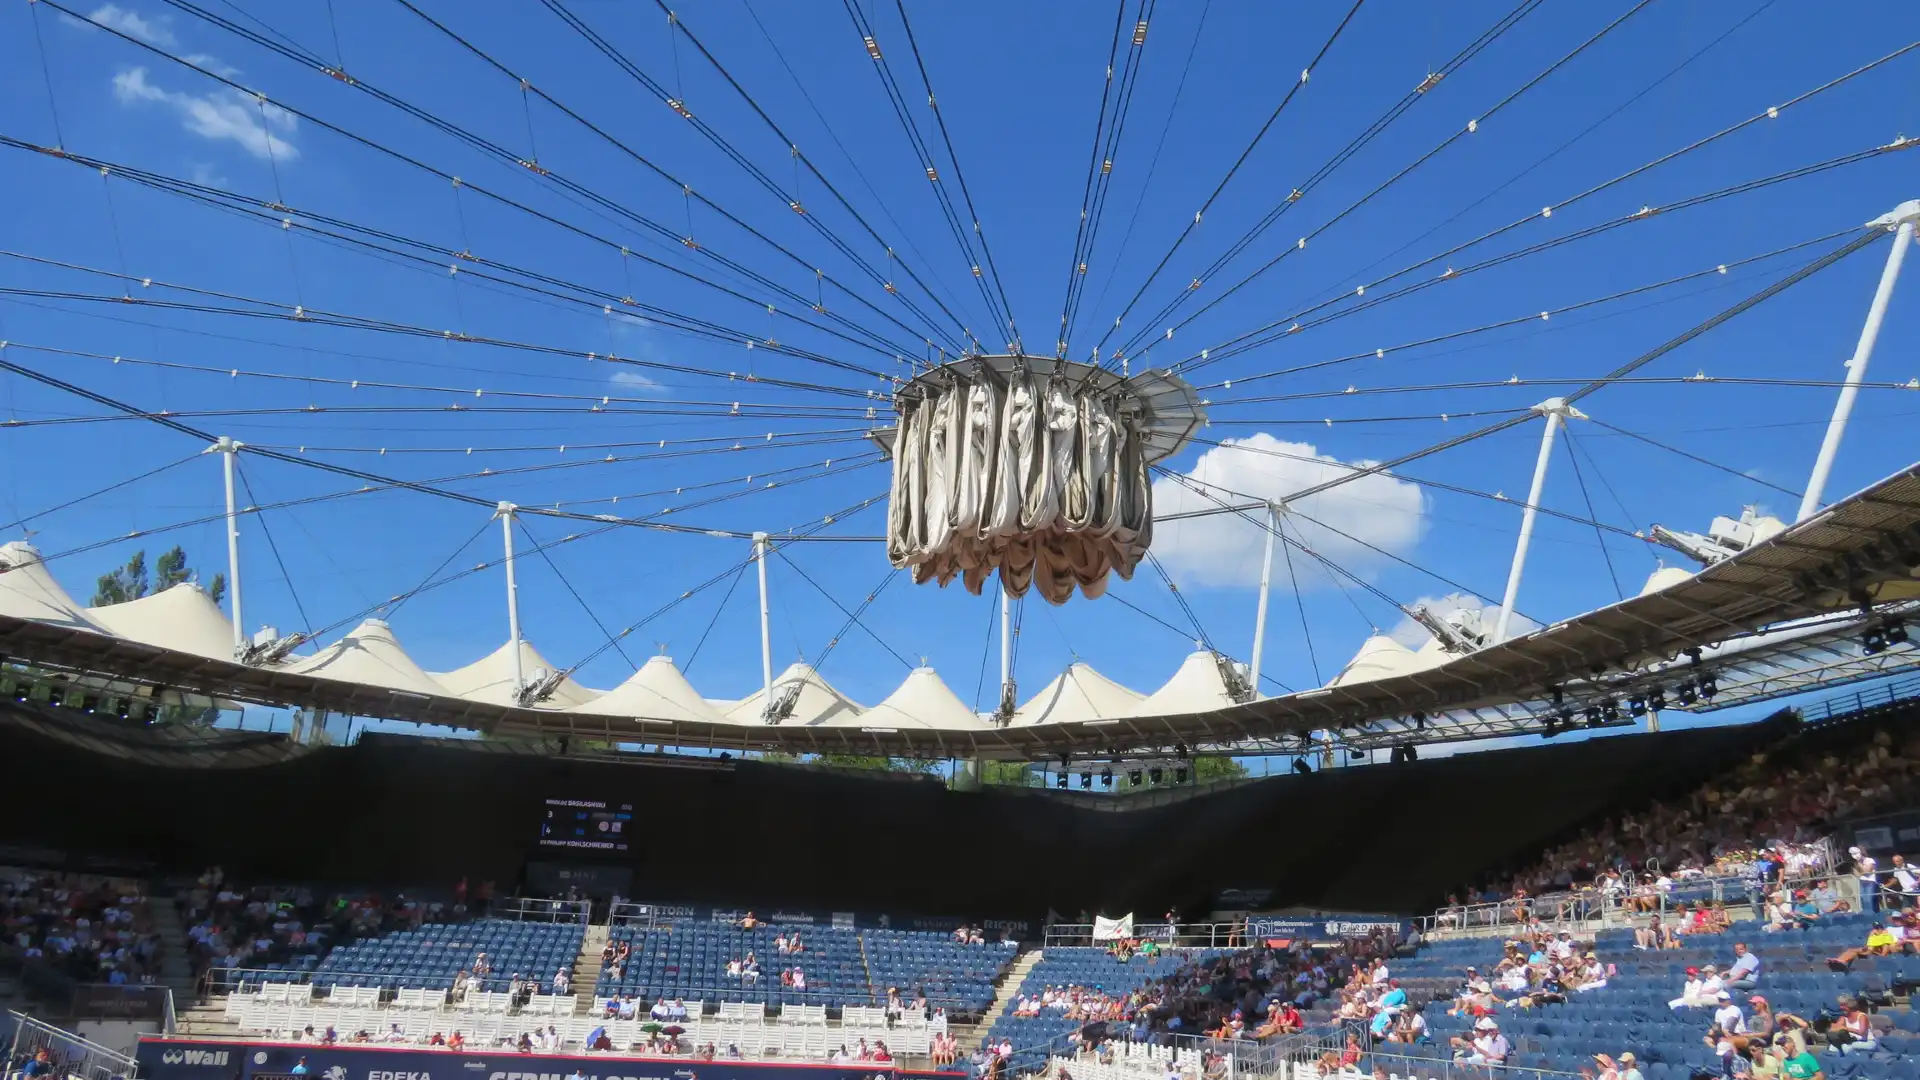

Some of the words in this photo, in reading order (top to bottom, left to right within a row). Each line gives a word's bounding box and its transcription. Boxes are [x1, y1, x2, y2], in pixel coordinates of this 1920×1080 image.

[984, 919, 1028, 931] RICOH
[185, 1050, 229, 1066] Wall
[368, 1071, 431, 1080] EDEKA
